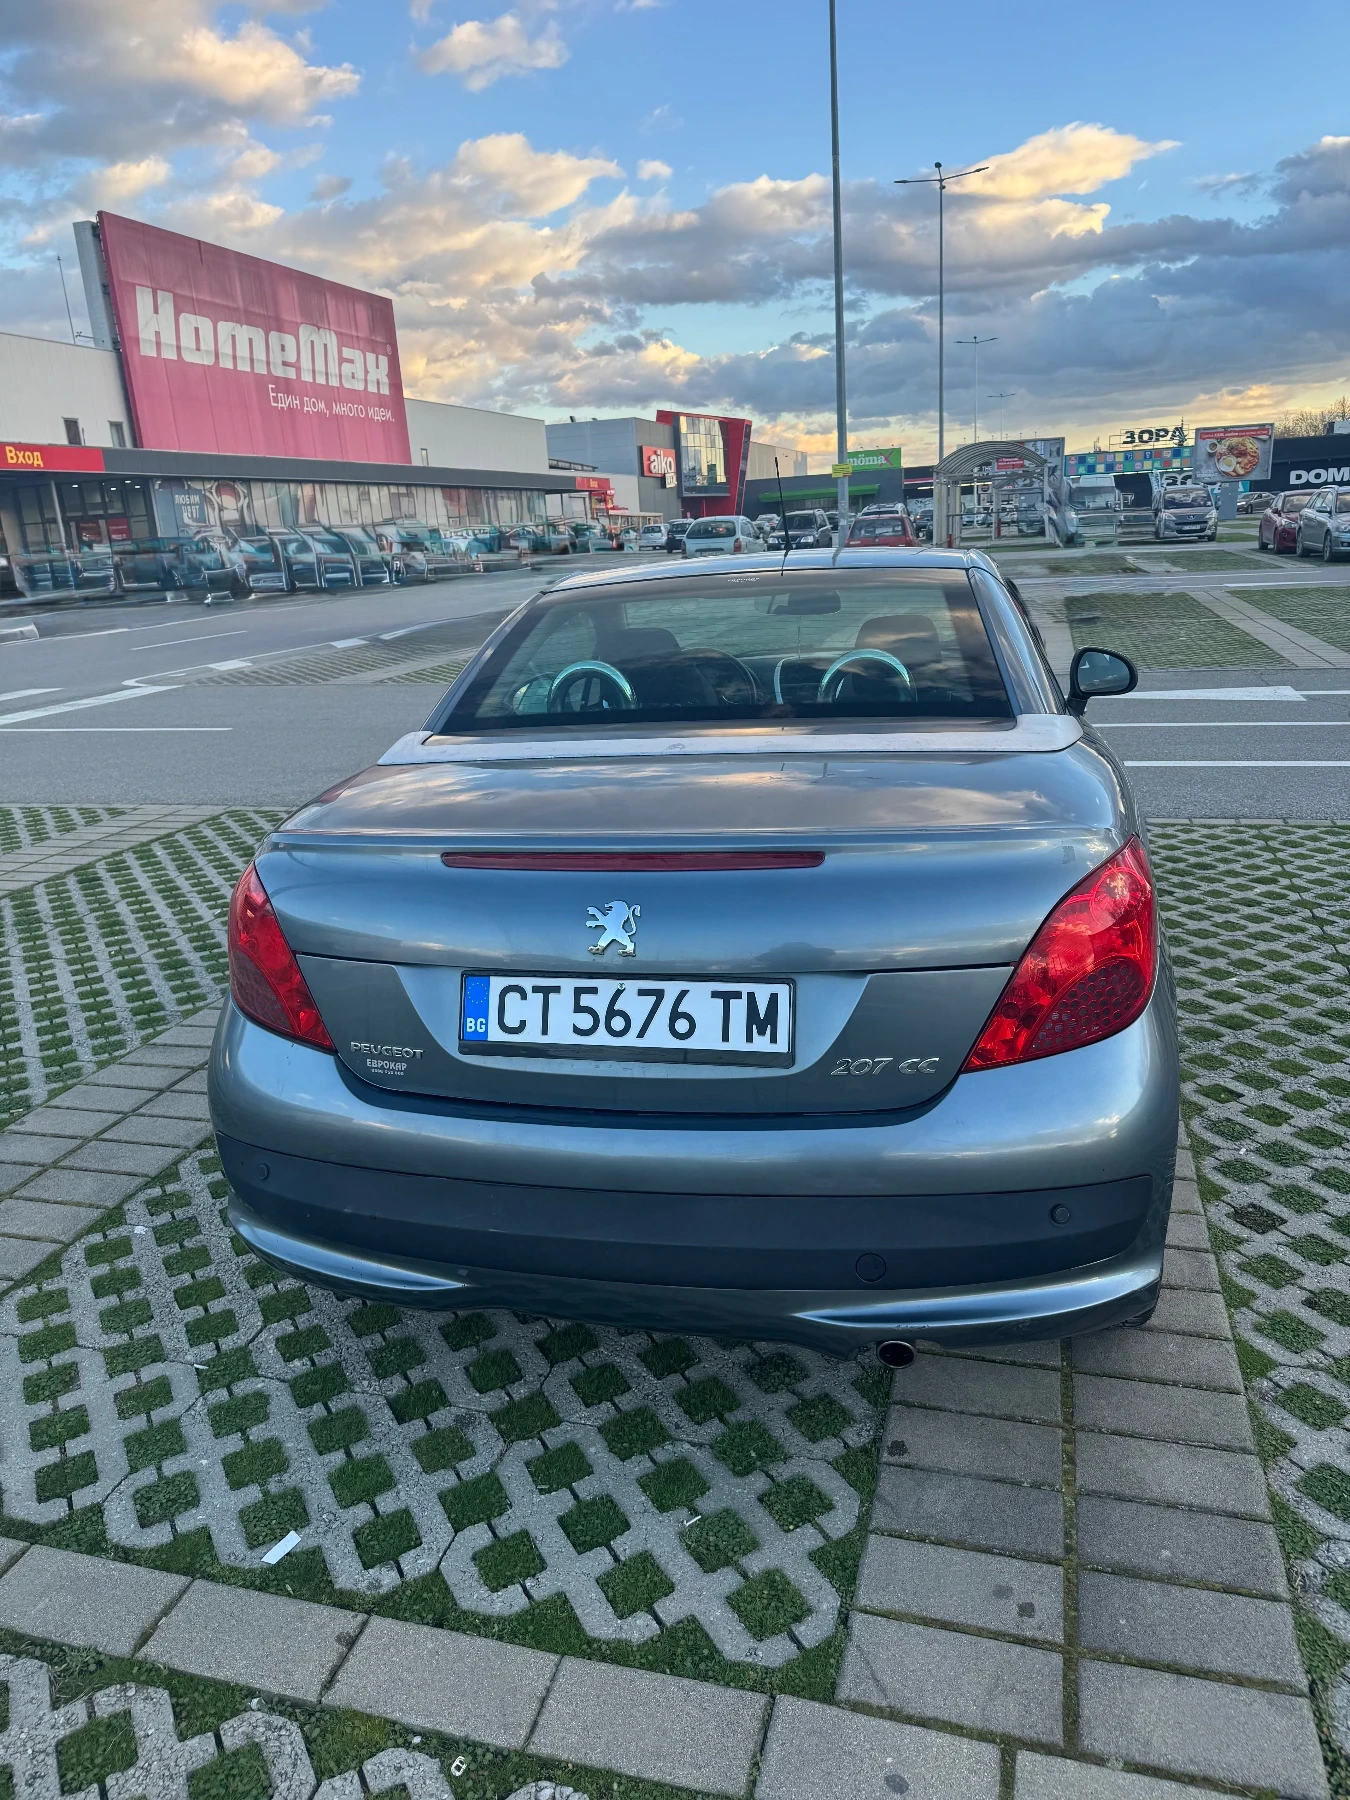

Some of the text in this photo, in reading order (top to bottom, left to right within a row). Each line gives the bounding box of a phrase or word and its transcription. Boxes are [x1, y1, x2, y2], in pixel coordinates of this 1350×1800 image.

[136, 285, 390, 395] HomeMax
[268, 384, 395, 423] Един дом, много идеи.
[1122, 427, 1186, 445] ЗОРА
[5, 446, 43, 467] Вход
[650, 449, 674, 474] aiko
[498, 985, 779, 1044] CT 5676 TM
[466, 1017, 486, 1032] BG
[350, 1041, 424, 1059] PEUGEOT
[366, 1058, 408, 1071] ЕВРОКАР
[830, 1058, 940, 1076] 207 CC
